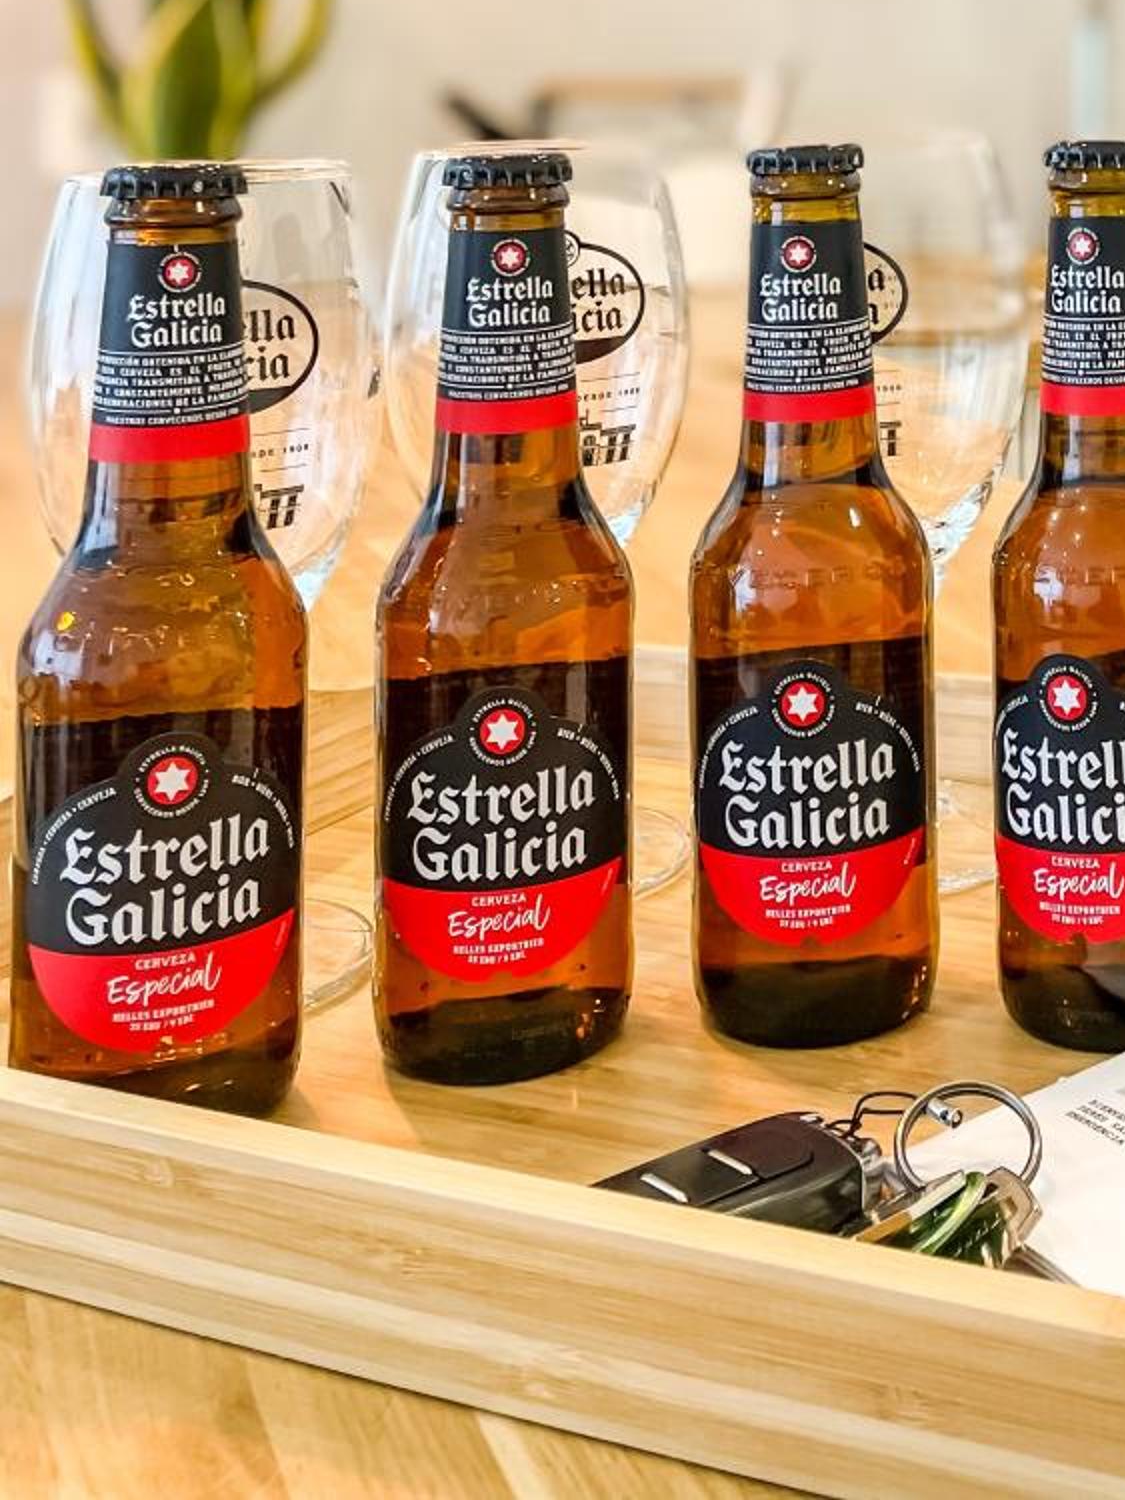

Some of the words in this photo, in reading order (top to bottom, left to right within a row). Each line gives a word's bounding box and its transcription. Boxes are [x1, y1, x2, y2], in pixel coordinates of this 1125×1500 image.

[466, 276, 554, 302] Estrella
[760, 273, 842, 298] Estrella
[1050, 263, 1125, 290] Estrella
[128, 292, 226, 322] Estrella
[468, 301, 551, 328] Galicia
[762, 297, 839, 323] Galicia
[1051, 289, 1121, 314] Galicia
[131, 317, 223, 348] Galicia
[719, 738, 897, 796] Estrella
[407, 764, 596, 827] Estrella
[725, 791, 890, 850] Galicia
[59, 813, 271, 886] Estrella
[412, 820, 588, 883] Galicia
[1051, 855, 1101, 869] CERVEZA
[781, 860, 832, 873] CERVEZA
[1033, 861, 1125, 902] Especial
[759, 861, 857, 907] Especial
[66, 873, 261, 946] Galicia
[471, 892, 528, 908] CERVEZA
[447, 893, 551, 942] Especial
[134, 952, 197, 971] CERVEZA
[106, 950, 222, 1007] Especial
